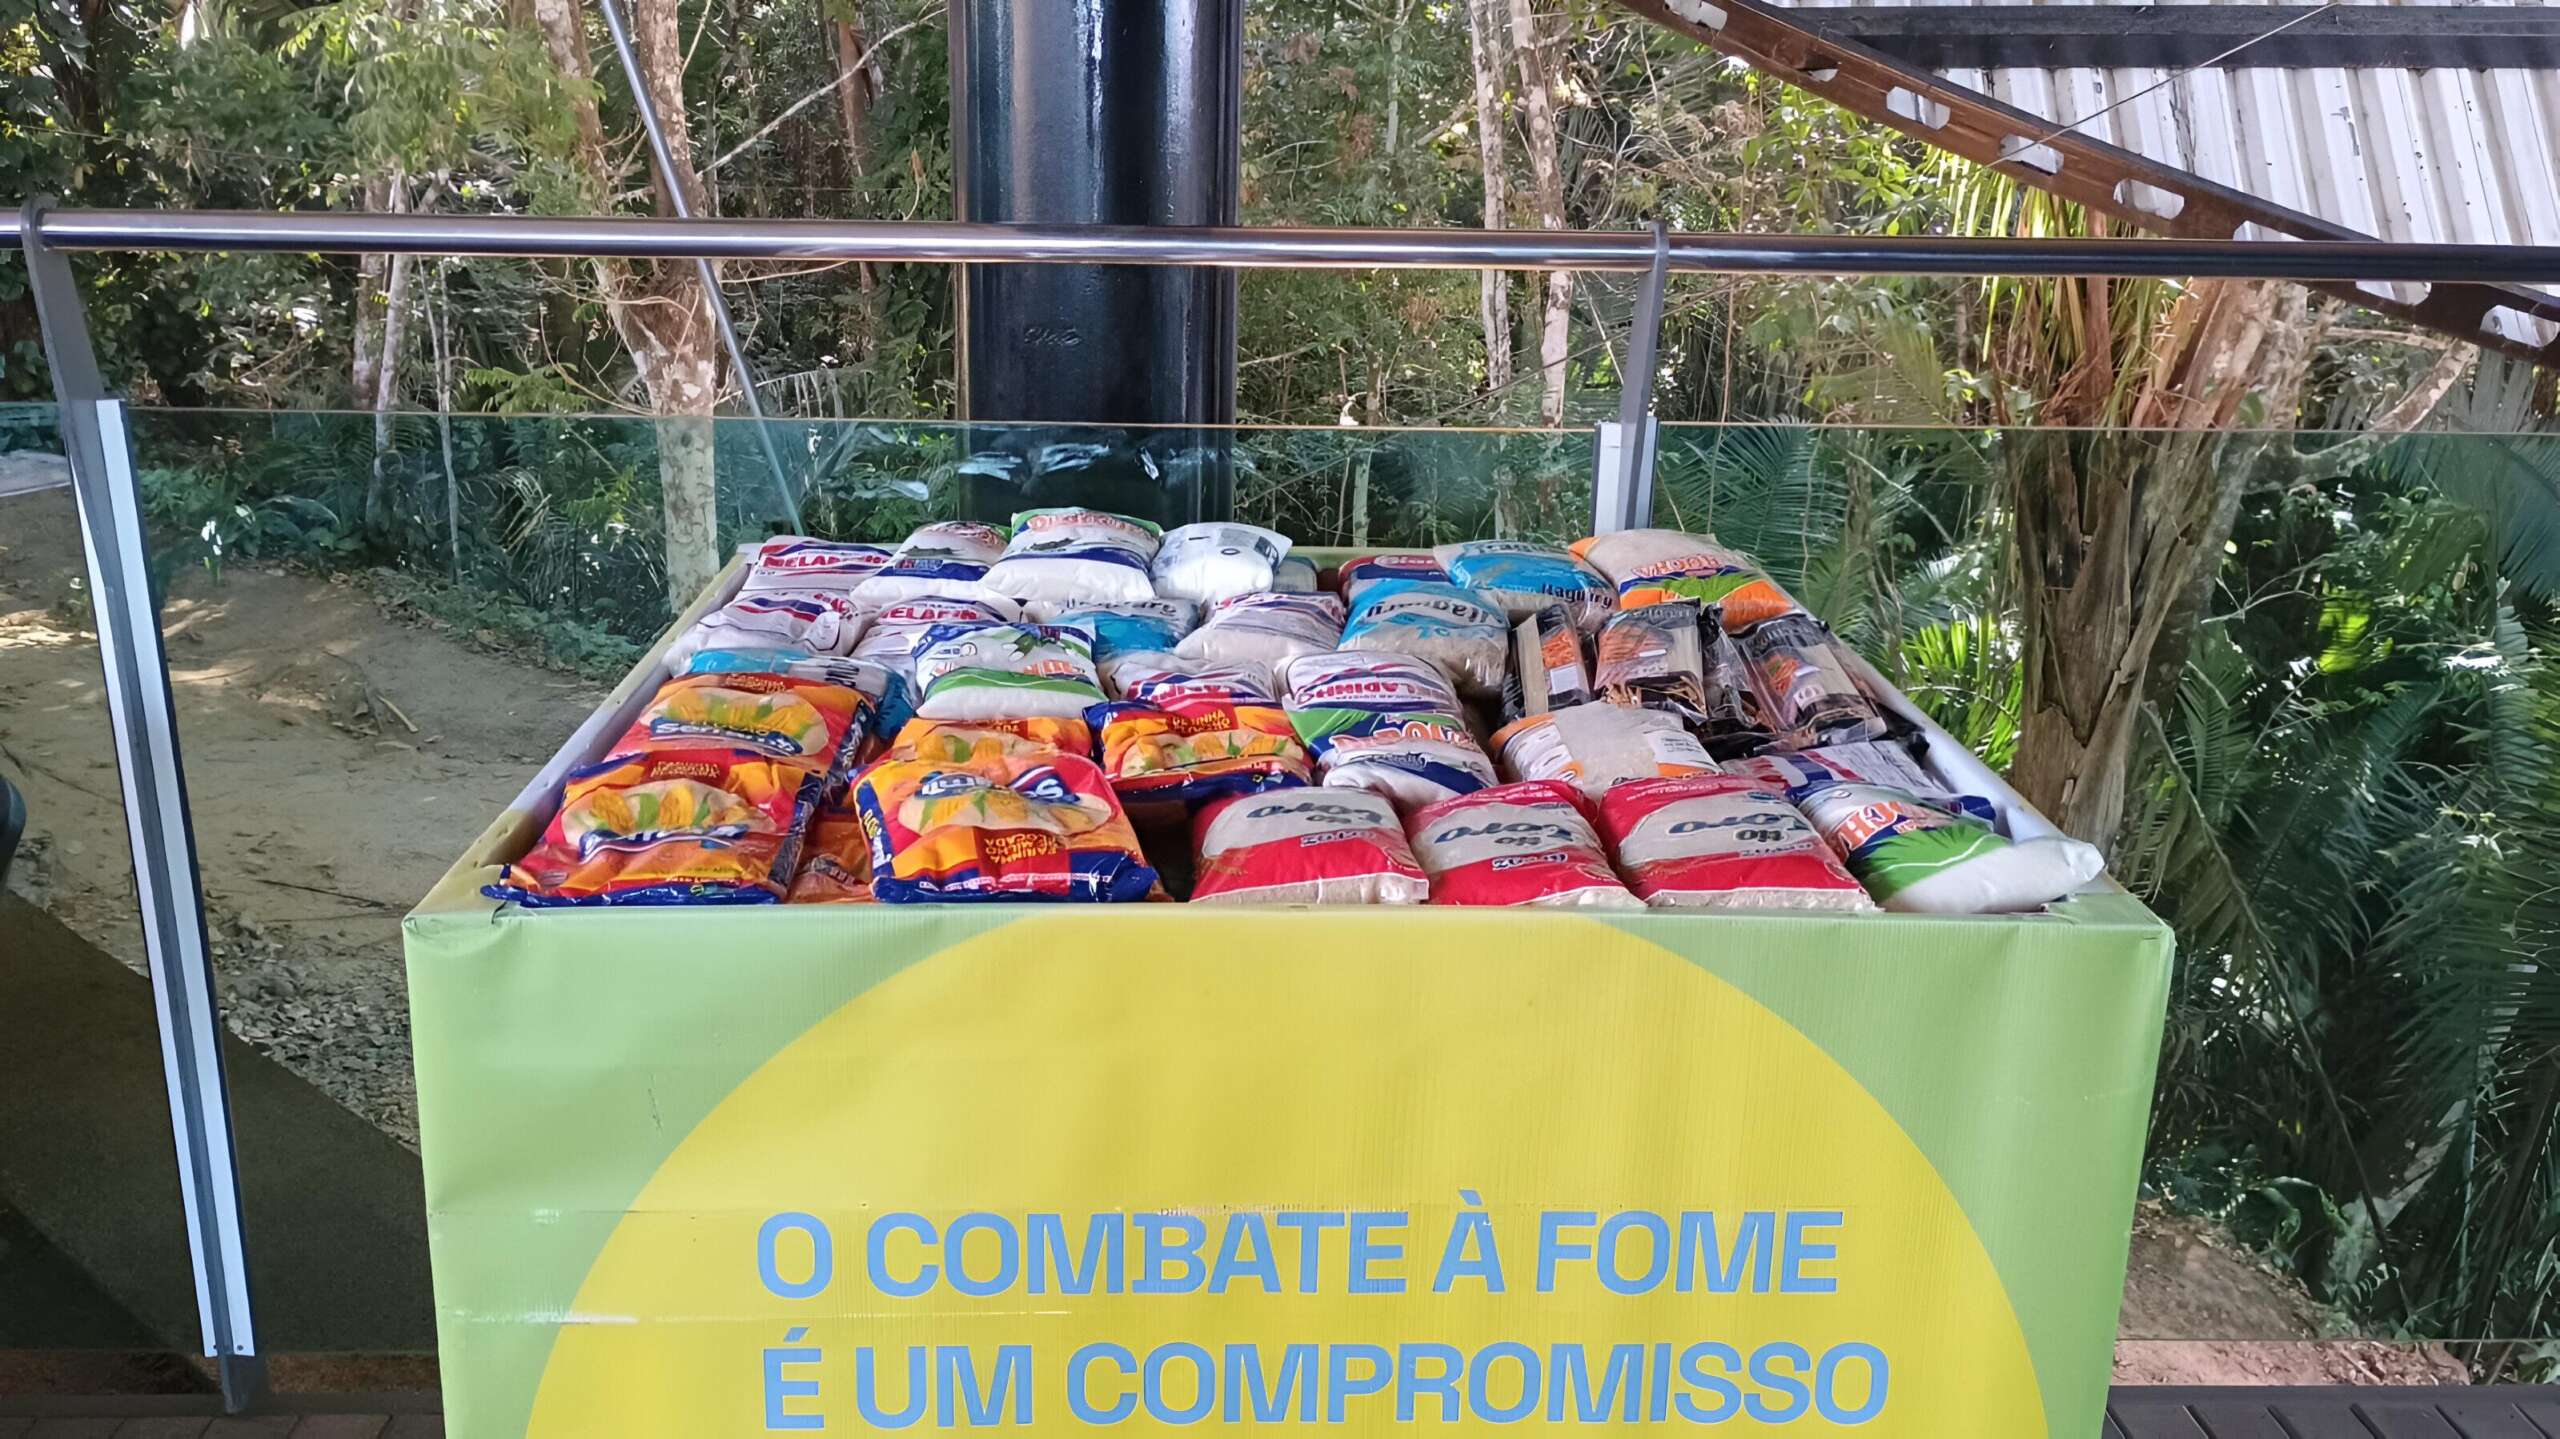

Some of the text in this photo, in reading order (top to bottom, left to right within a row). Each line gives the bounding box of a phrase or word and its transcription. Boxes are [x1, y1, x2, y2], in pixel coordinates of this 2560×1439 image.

[759, 1191, 1842, 1298] O COMBATE À FOME
[765, 1328, 1888, 1428] É UM COMPROMISSO
